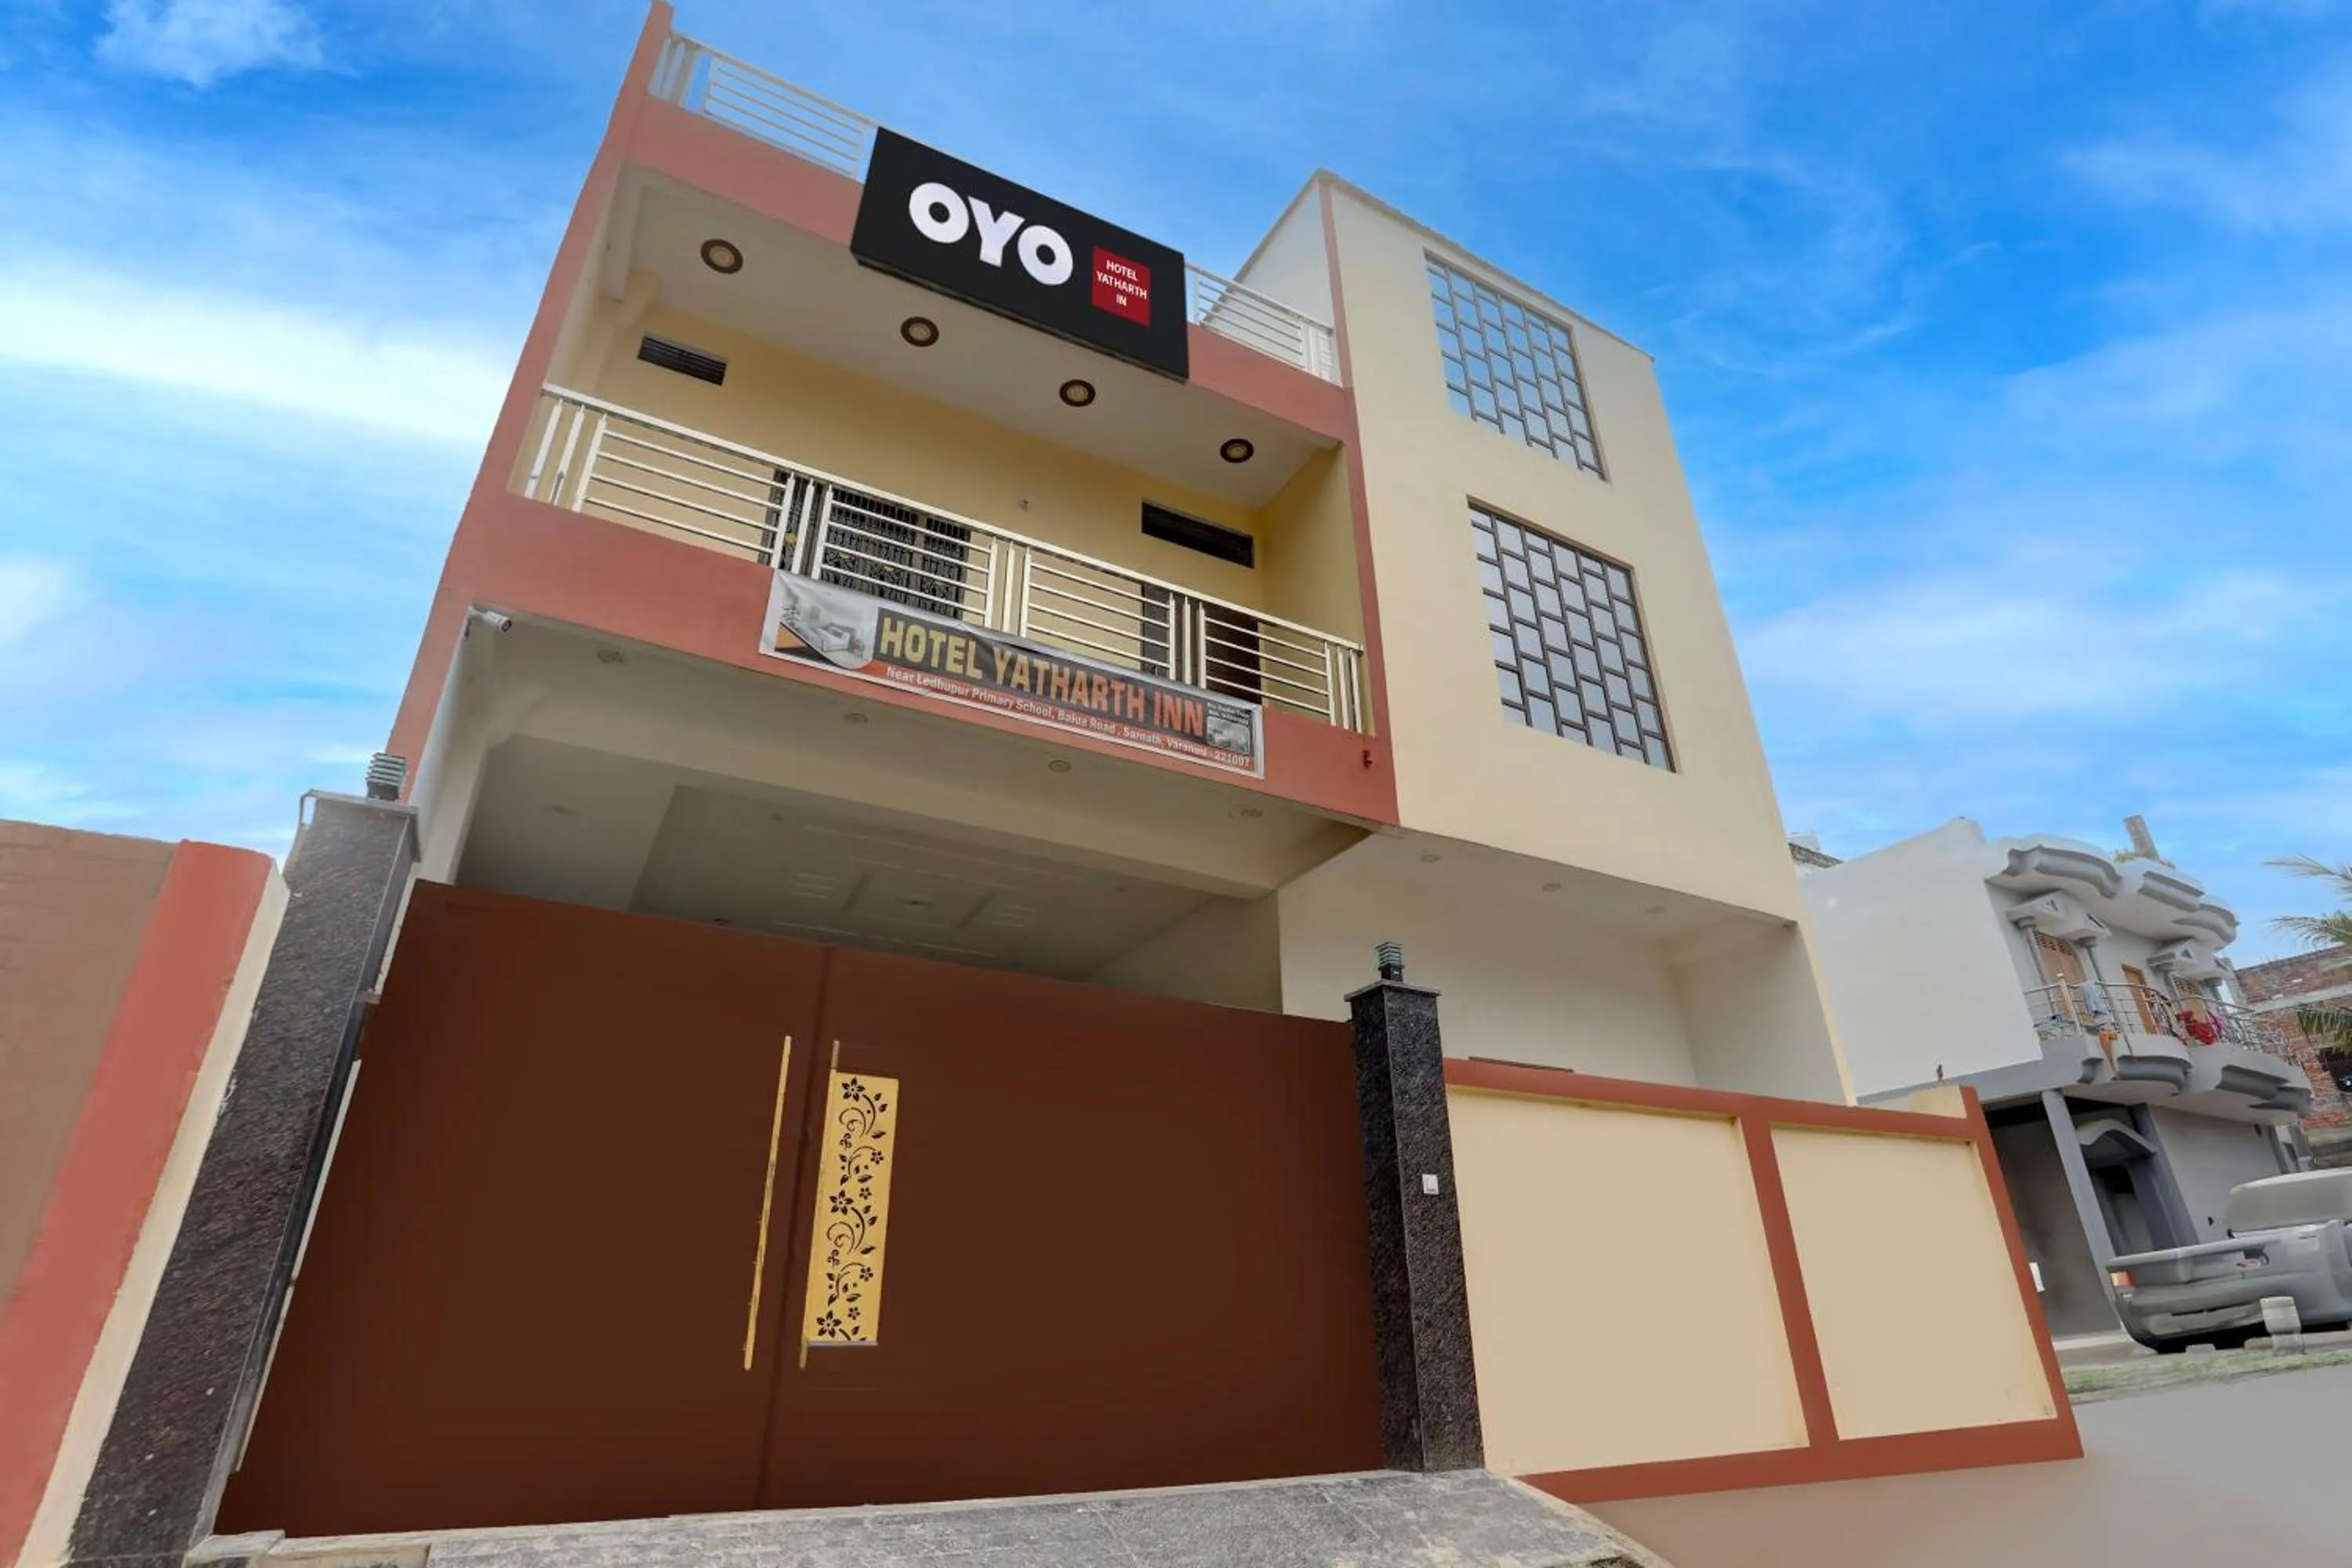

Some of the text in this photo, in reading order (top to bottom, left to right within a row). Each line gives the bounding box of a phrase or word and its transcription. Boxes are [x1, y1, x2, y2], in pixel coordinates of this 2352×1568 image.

[909, 182, 1073, 286] OYO
[1096, 270, 1147, 299] YATHARTH
[1106, 260, 1138, 281] HOTEL
[1116, 294, 1127, 307] IN
[880, 617, 1203, 737] HOTEL YATHARTH INN
[887, 666, 915, 683] Near
[916, 673, 969, 695] Ledhupur
[971, 687, 1013, 710] Primary
